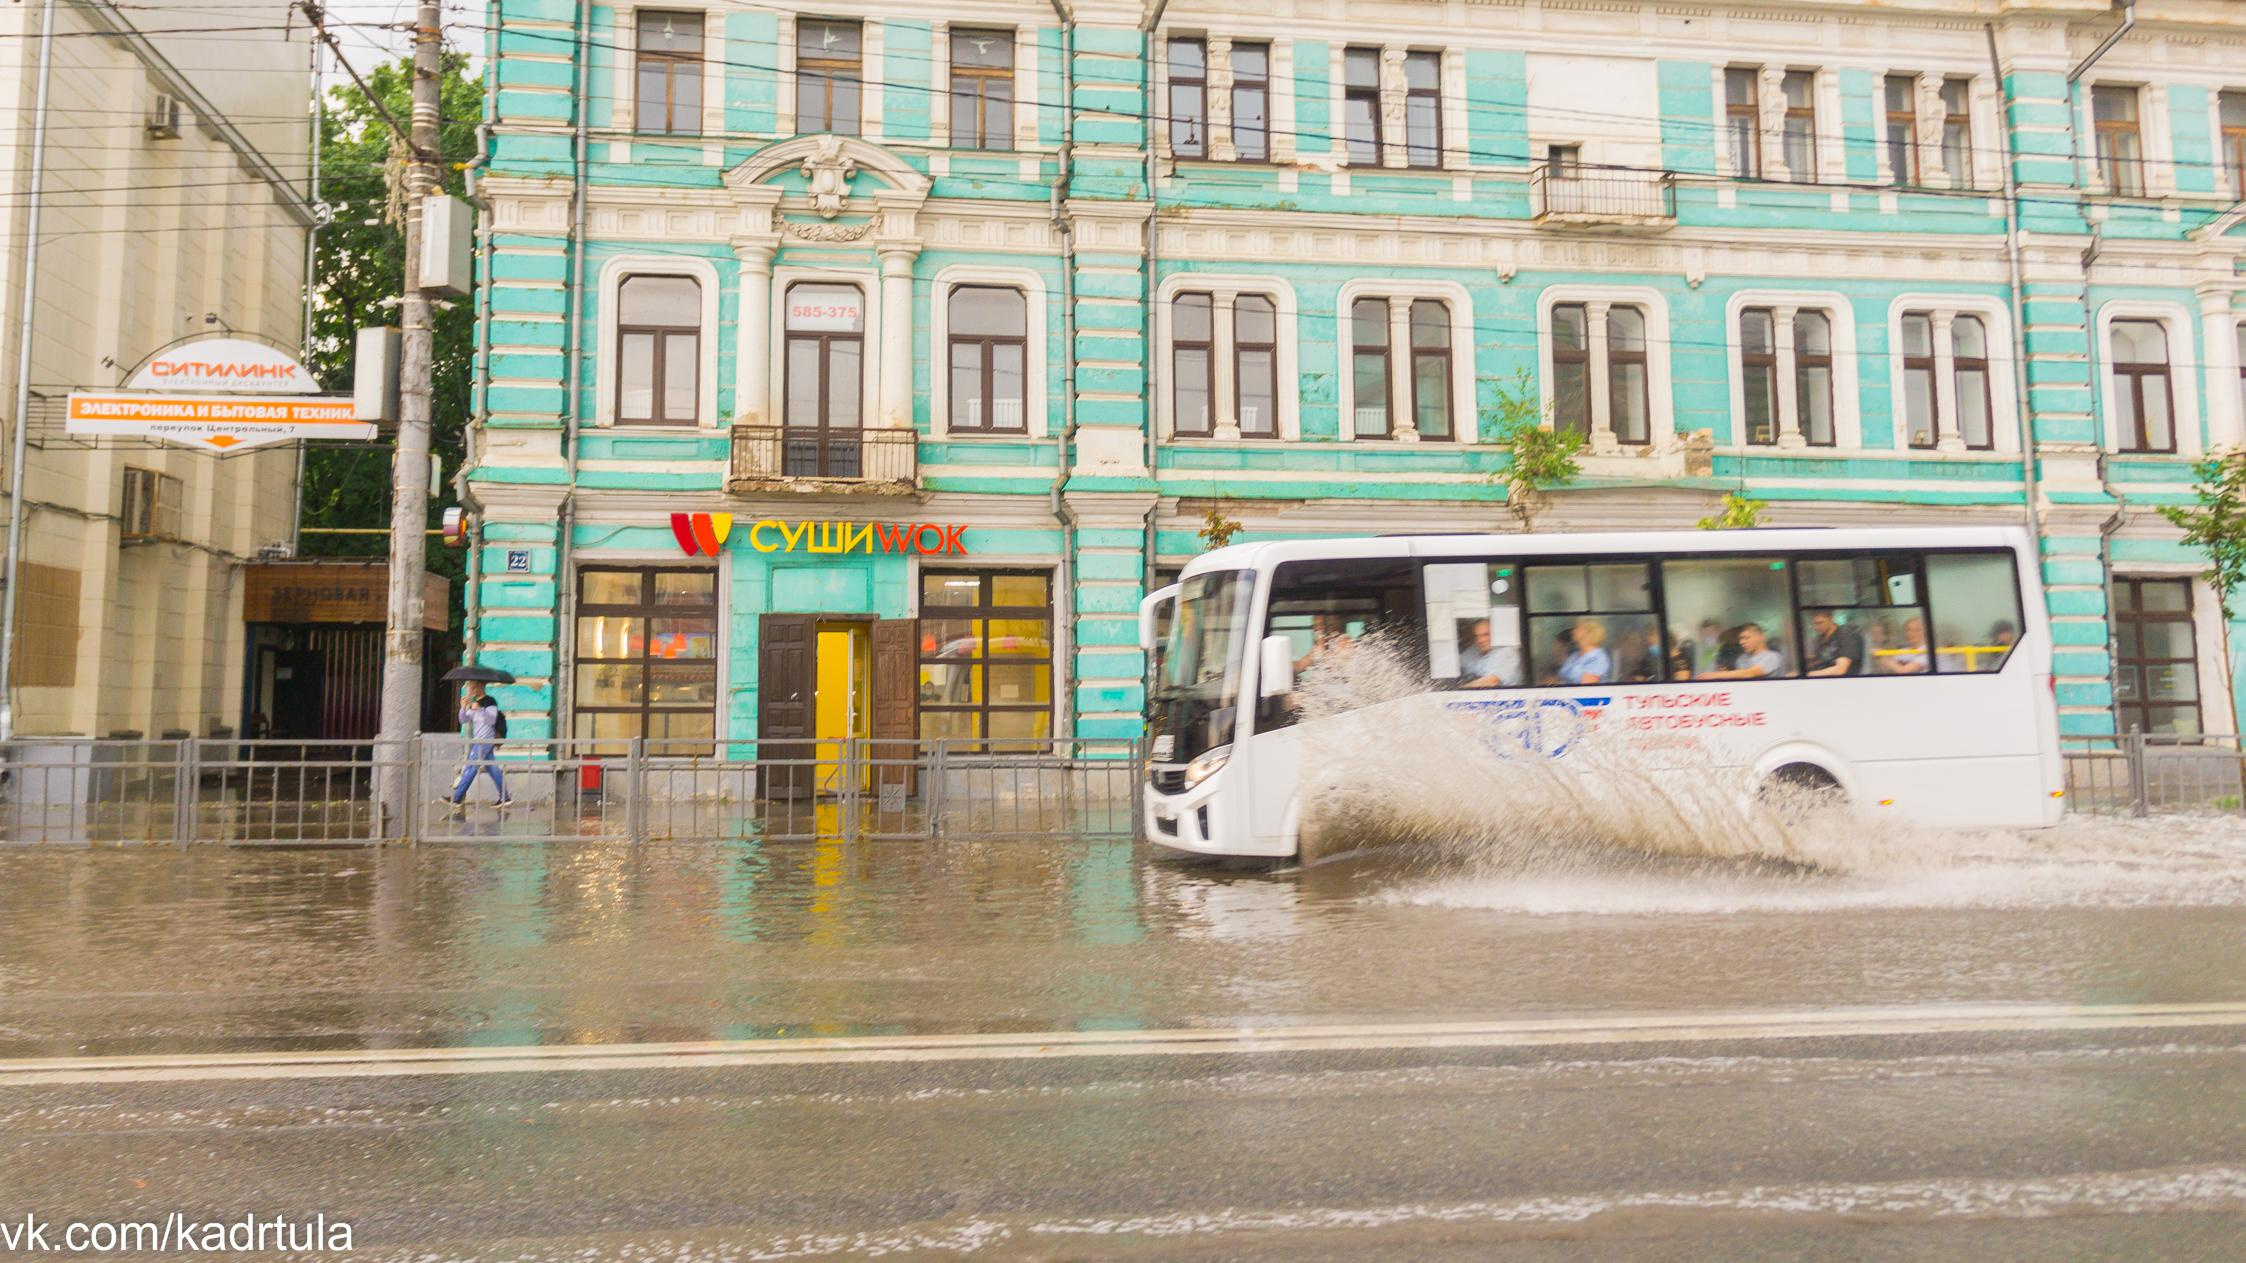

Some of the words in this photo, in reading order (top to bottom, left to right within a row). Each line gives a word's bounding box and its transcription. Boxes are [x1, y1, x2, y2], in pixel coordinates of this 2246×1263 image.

[792, 305, 857, 318] 585-375
[151, 361, 297, 379] СИТИЛИНК
[80, 402, 195, 418] ЭЛЕКТРОНИКА
[197, 405, 209, 418] И
[211, 405, 287, 419] БЫТОВАЯ
[291, 407, 357, 420] ТЕХНИК
[150, 424, 203, 433] переулок
[510, 554, 527, 568] 22
[1624, 692, 1732, 709] ТУЛЬСКИЕ
